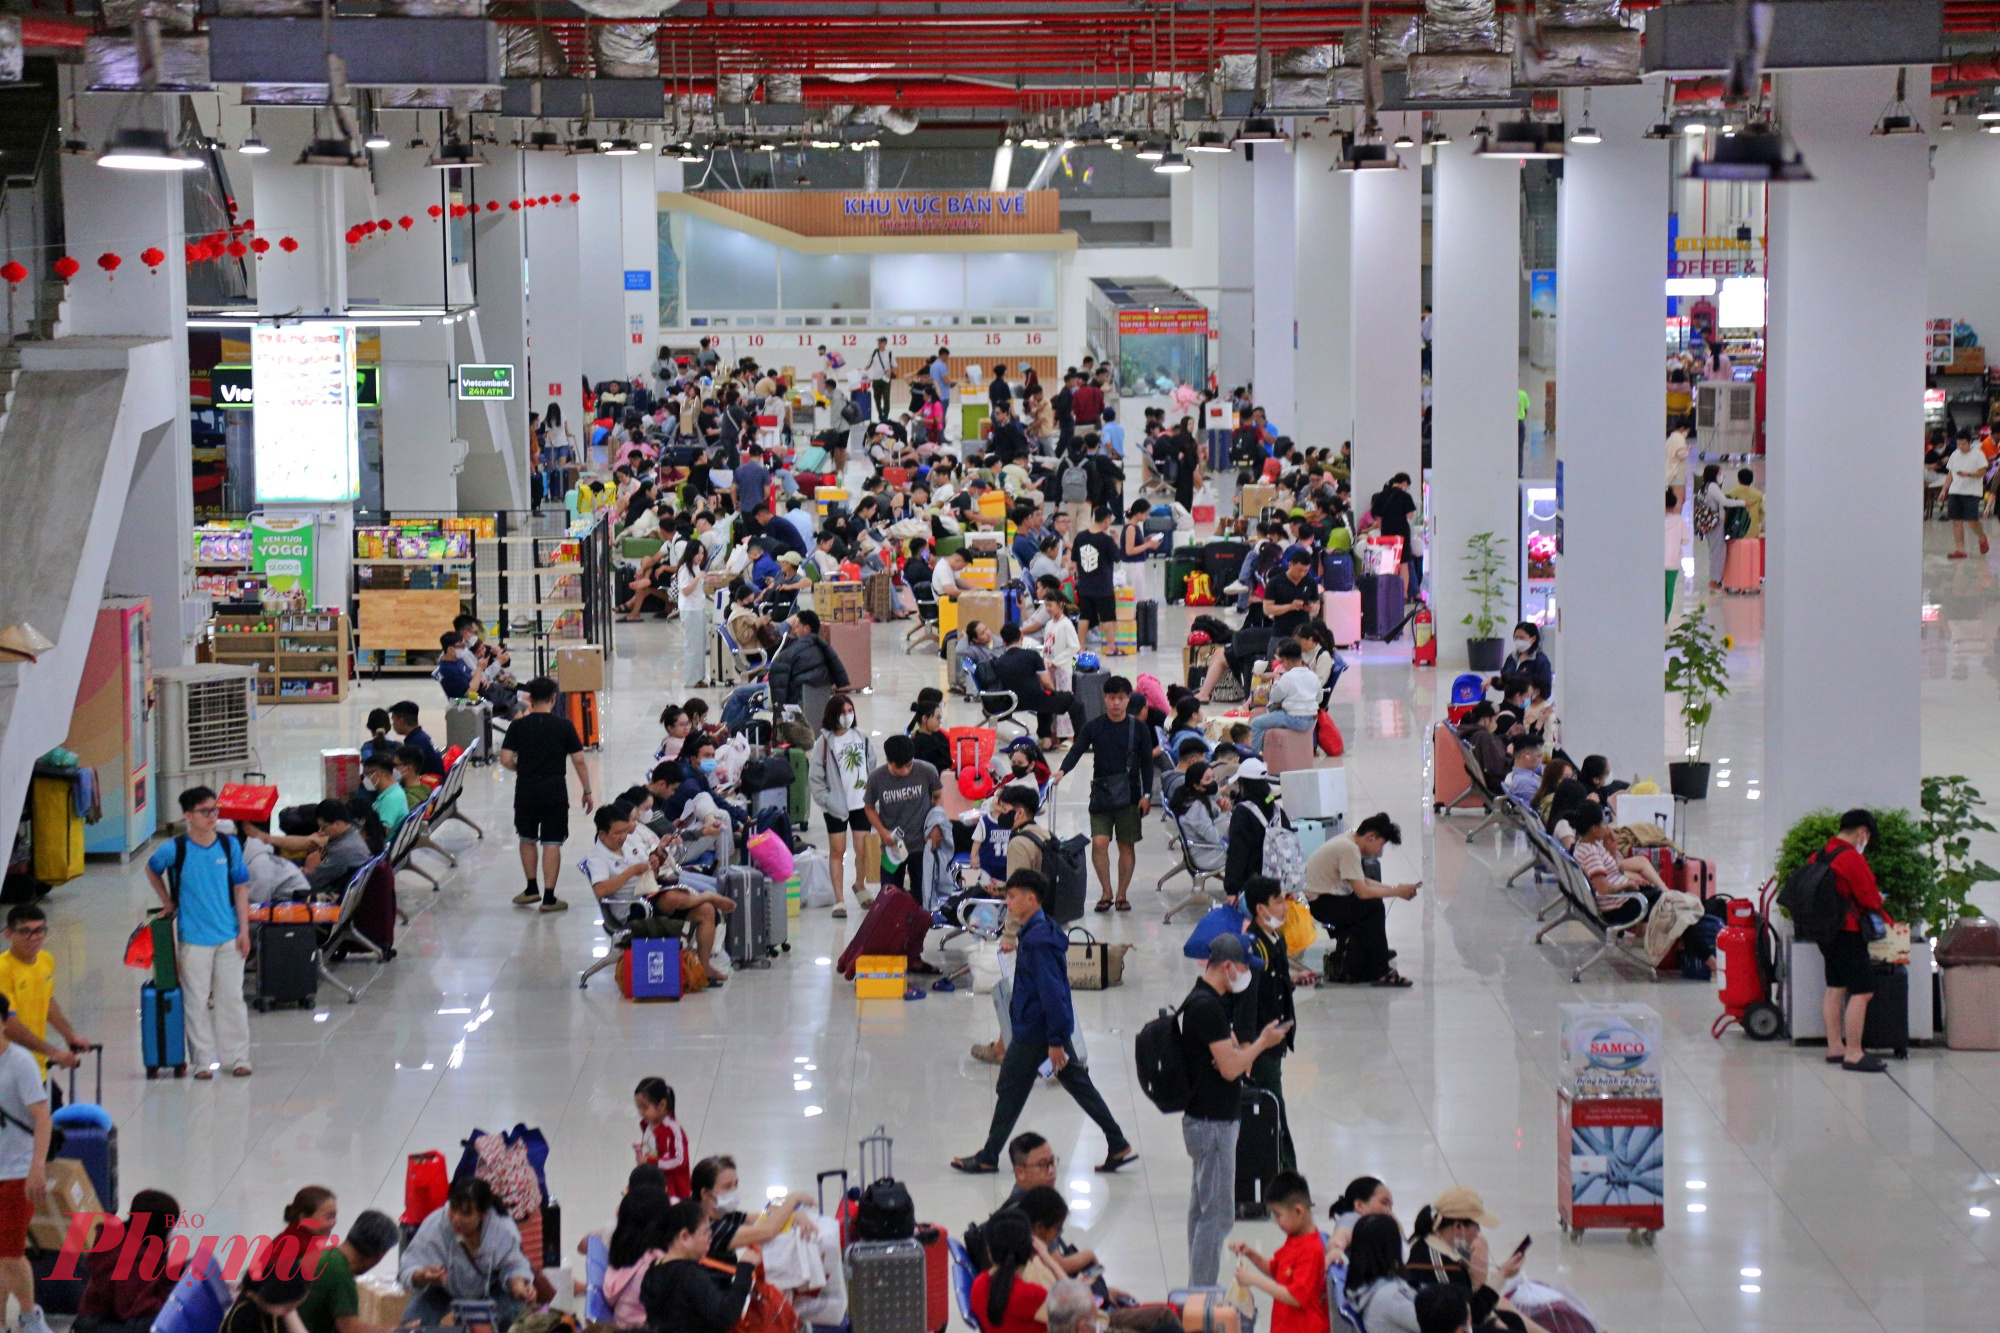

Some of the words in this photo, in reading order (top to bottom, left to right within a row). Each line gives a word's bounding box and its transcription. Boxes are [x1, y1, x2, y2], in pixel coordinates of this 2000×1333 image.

[845, 197, 890, 215] KHU
[897, 195, 942, 219] VỰC
[947, 192, 993, 215] BÁN
[998, 191, 1026, 215] VÉ
[881, 219, 939, 231] TICKETS
[944, 219, 982, 230] AREA
[1667, 259, 1738, 276] OFFEE
[1743, 259, 1756, 274] &
[748, 335, 764, 346] 10
[798, 335, 812, 346] 11
[842, 334, 857, 346] 12
[892, 334, 907, 346] 13
[934, 334, 949, 346] 14
[985, 333, 1001, 345] 15
[1026, 333, 1042, 345] 16
[462, 379, 510, 387] Vietcombank
[468, 387, 485, 395] 24h
[486, 387, 504, 395] ATM
[262, 535, 280, 543] KEM
[257, 544, 308, 556] YOGGI
[1590, 1042, 1645, 1054] SAMCO
